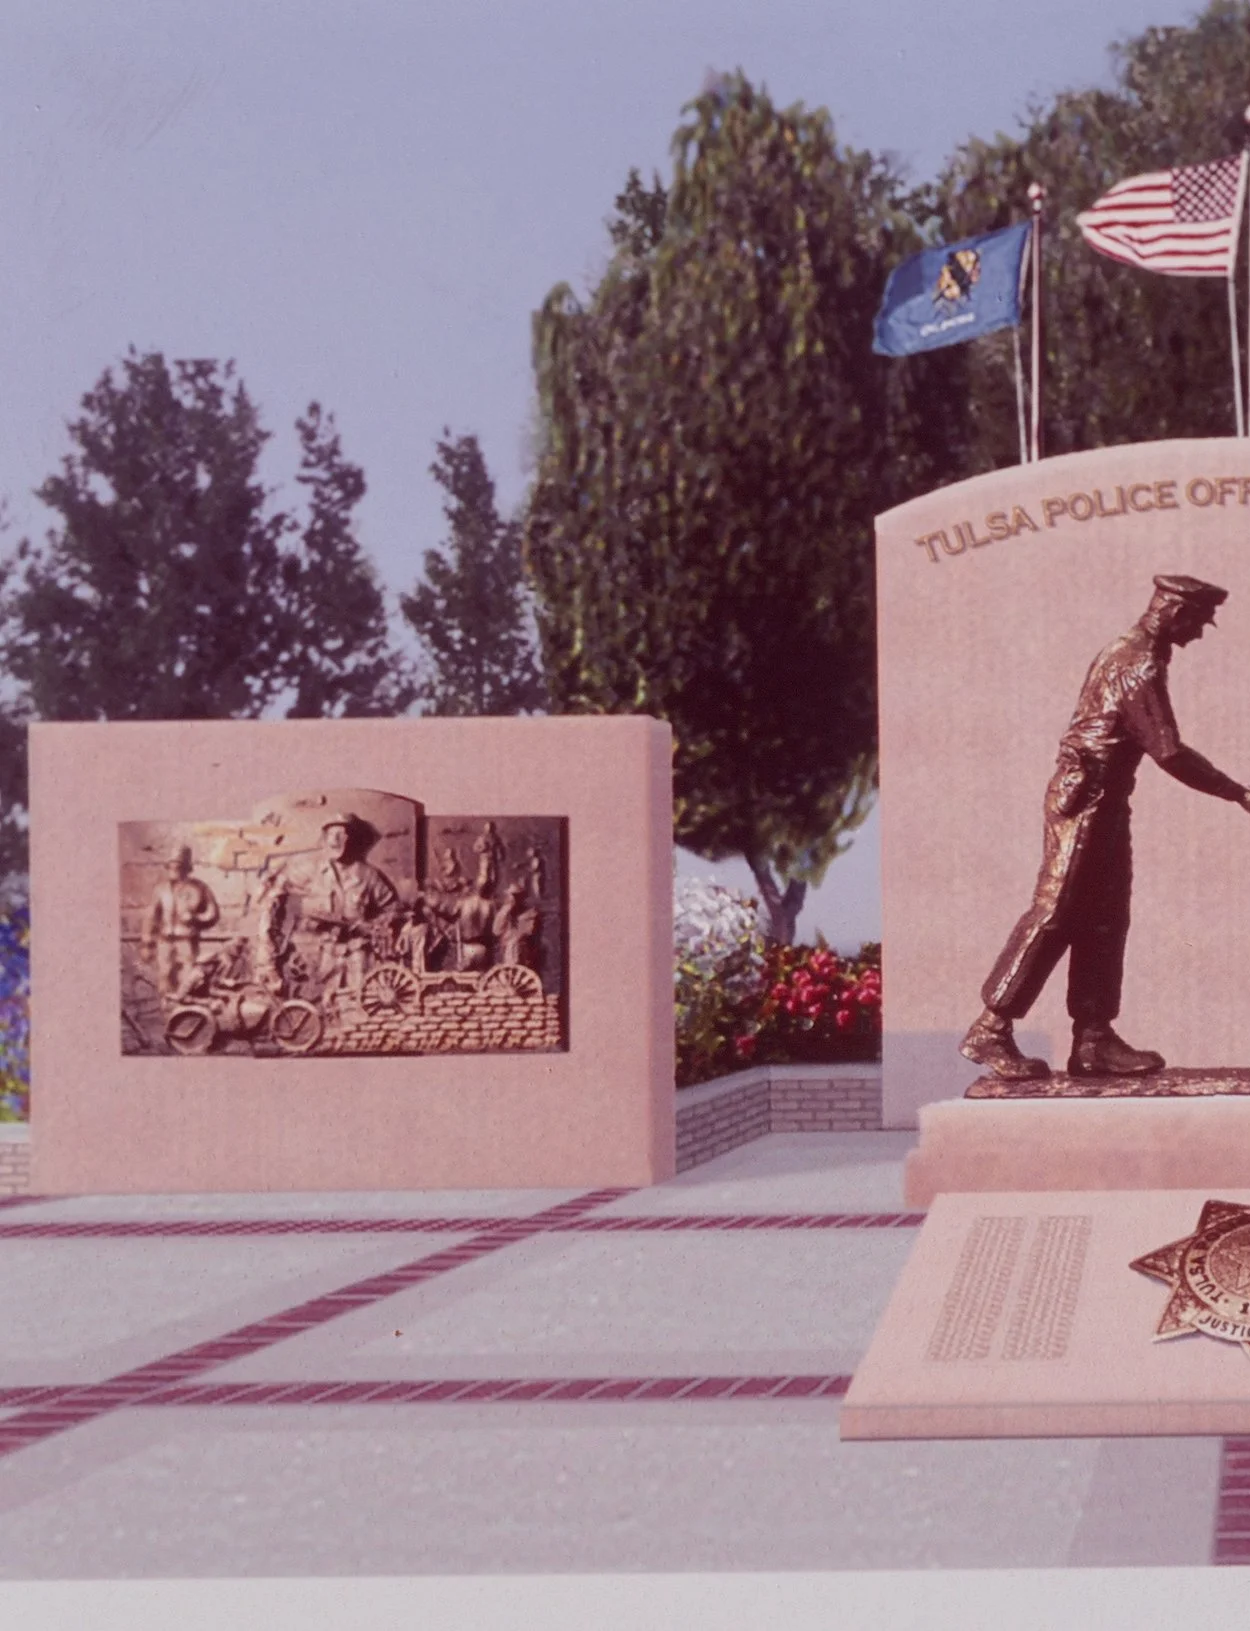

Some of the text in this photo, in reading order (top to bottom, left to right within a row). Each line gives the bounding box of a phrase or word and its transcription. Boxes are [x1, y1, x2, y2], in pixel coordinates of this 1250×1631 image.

[915, 504, 1038, 563] TULSA
[1043, 479, 1179, 527] POLICE
[1188, 1254, 1224, 1304] TULSA
